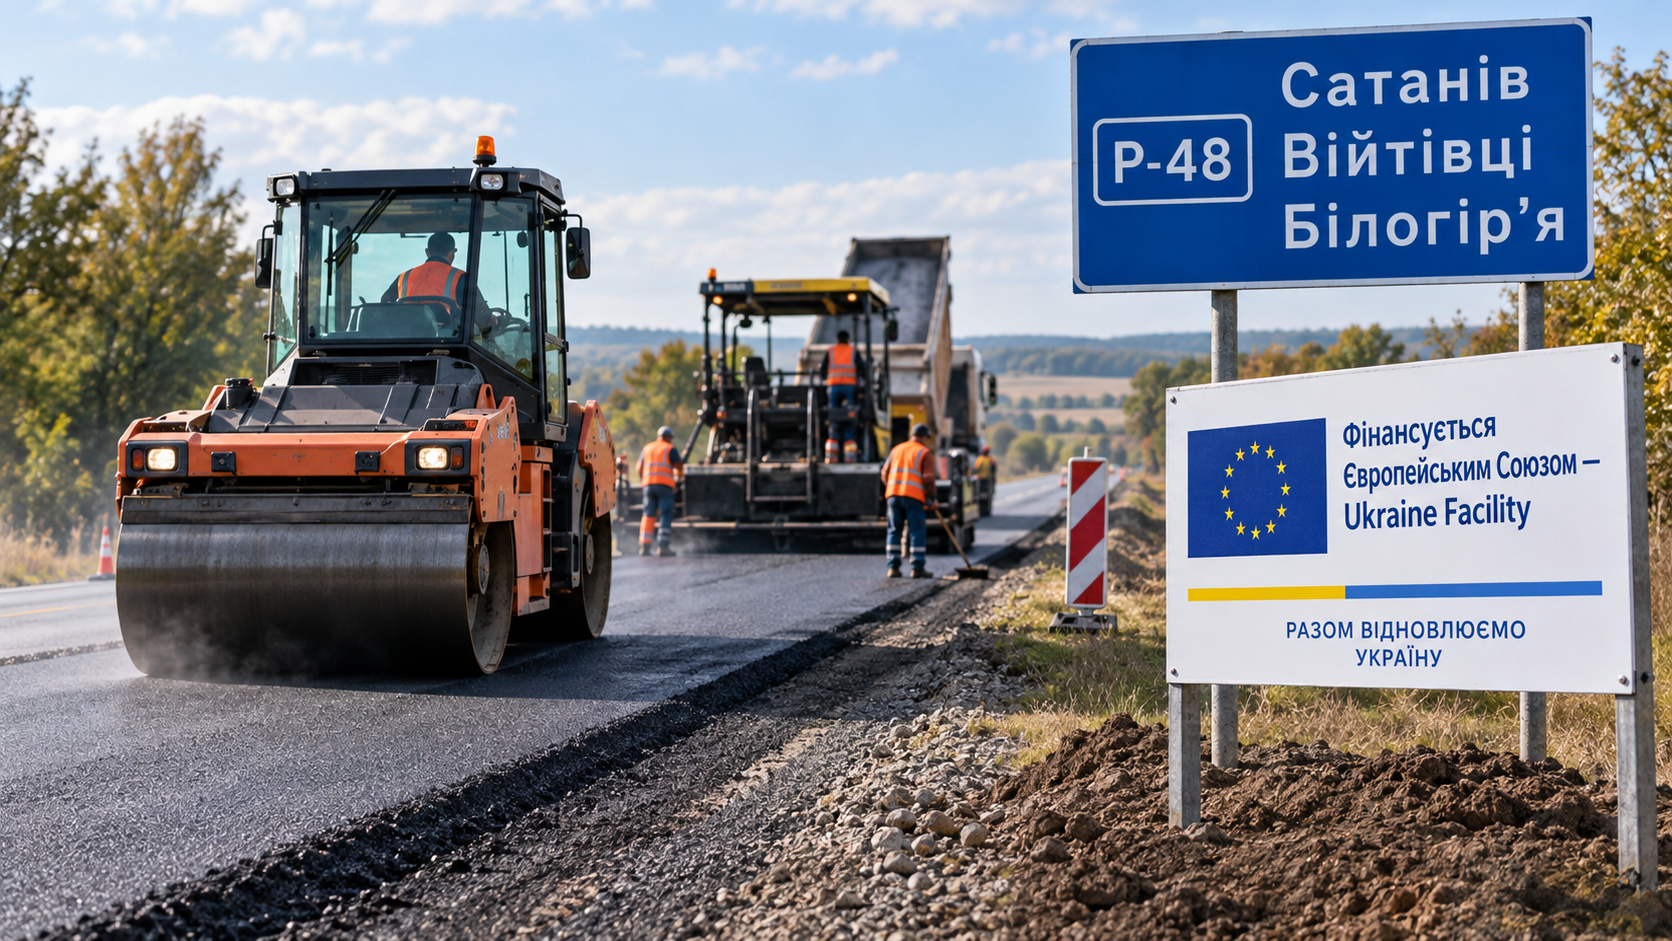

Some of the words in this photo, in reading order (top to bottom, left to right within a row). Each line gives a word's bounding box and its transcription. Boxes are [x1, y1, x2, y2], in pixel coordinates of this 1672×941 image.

[1282, 54, 1529, 108] Сатанів
[1114, 137, 1232, 184] Р-48
[1284, 124, 1532, 179] Війтівці
[1285, 196, 1564, 255] Білогір’я
[1342, 416, 1496, 450] Фінансується
[1343, 457, 1491, 494] Європейським
[1496, 450, 1577, 479] Союзом
[1344, 498, 1438, 531] Ukraine
[1444, 493, 1532, 531] Facility
[1286, 620, 1353, 640] РАЗОМ
[1361, 620, 1526, 643] ВІДНОВЛЮЄМО
[1355, 645, 1443, 667] УКРАЇНУ
